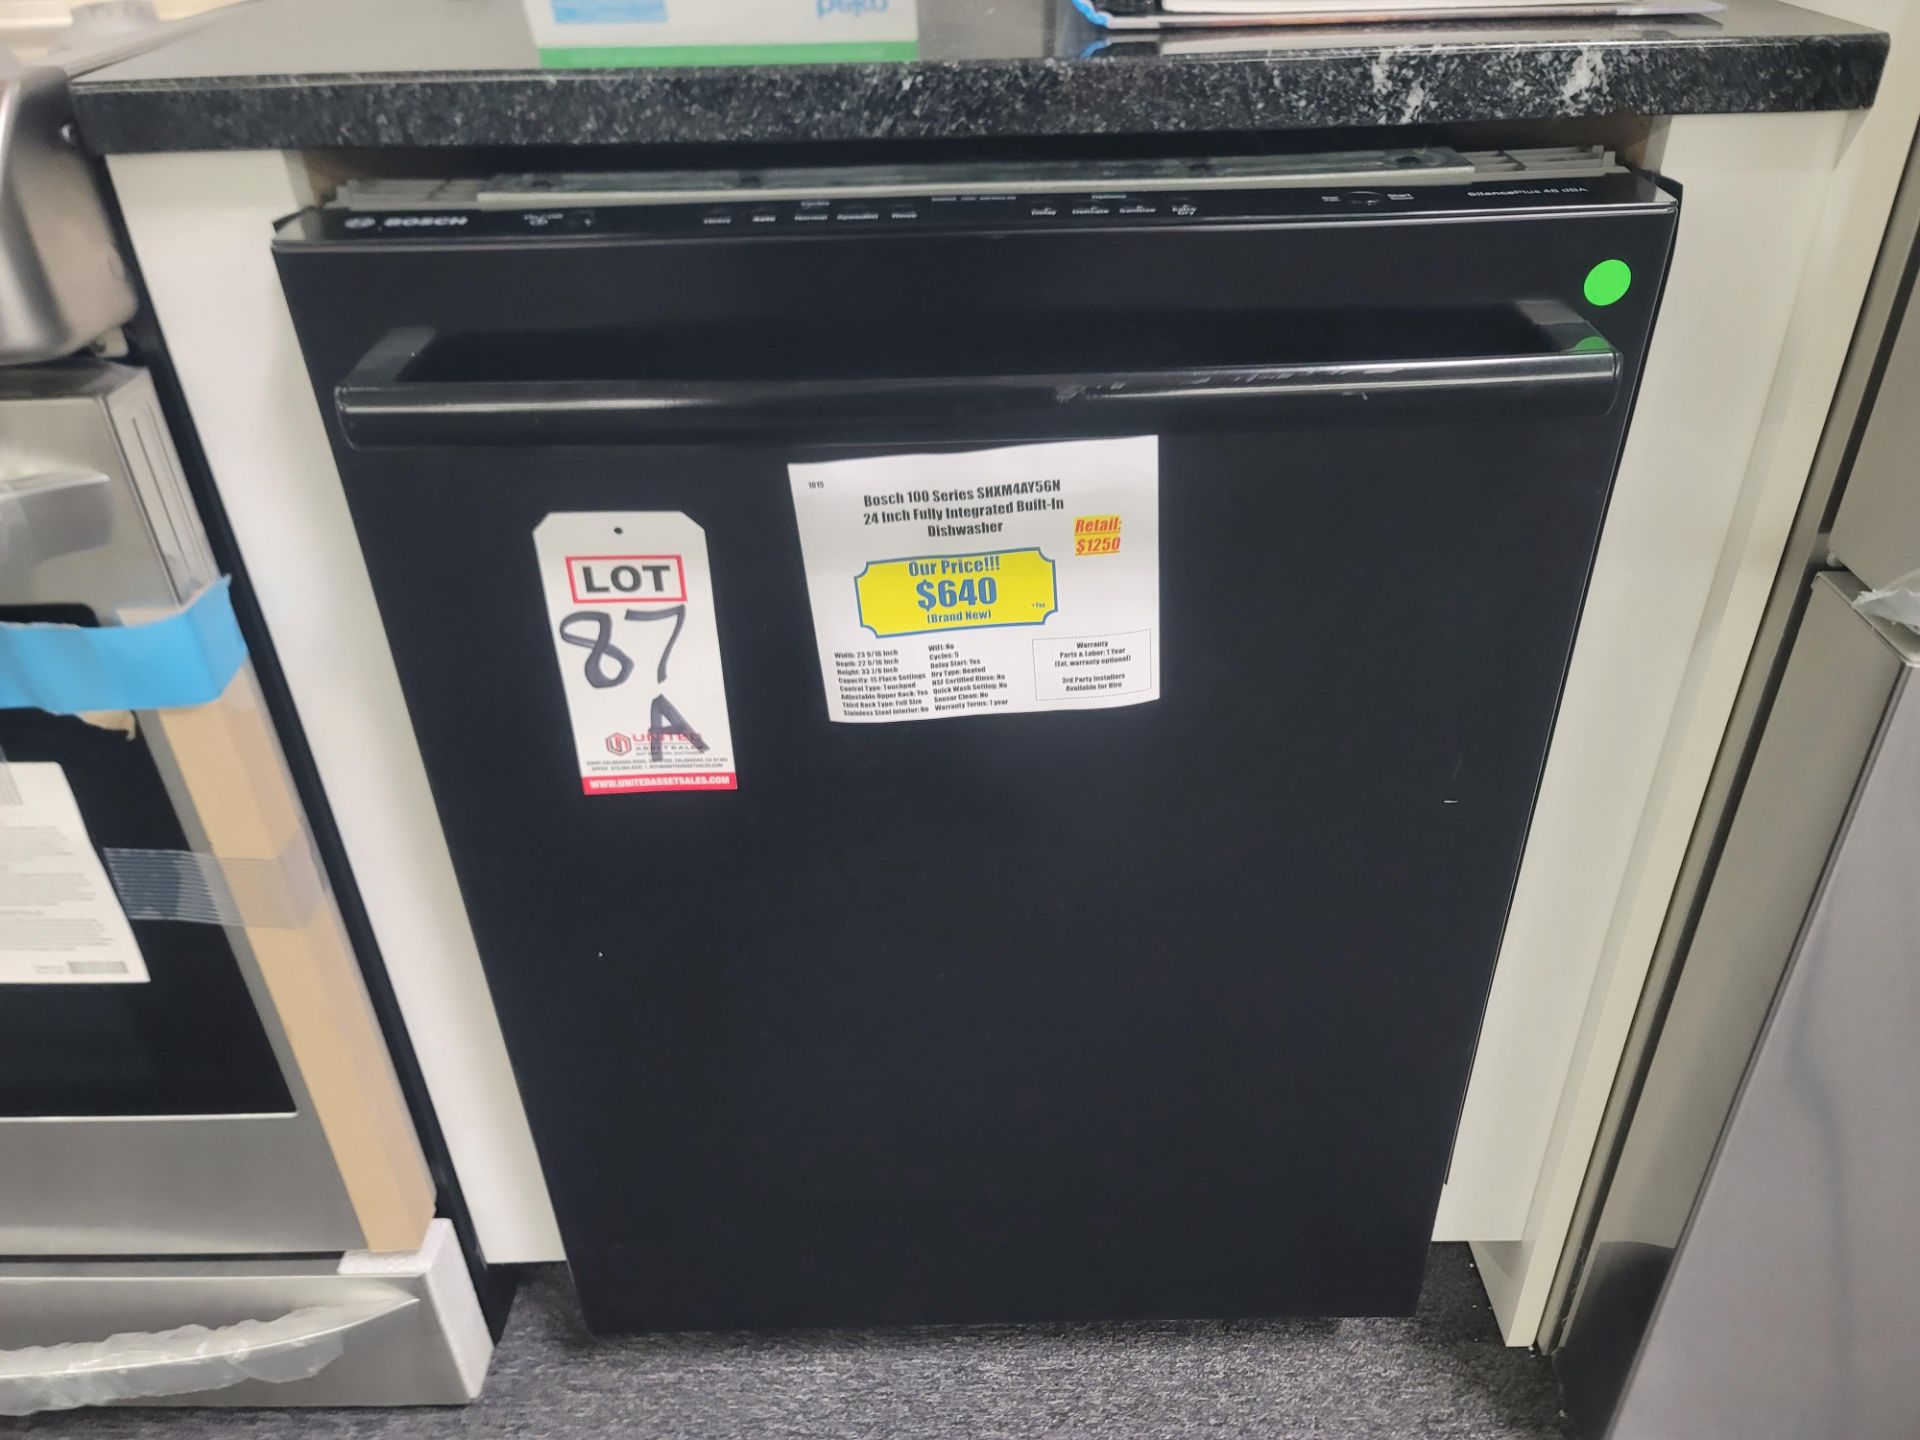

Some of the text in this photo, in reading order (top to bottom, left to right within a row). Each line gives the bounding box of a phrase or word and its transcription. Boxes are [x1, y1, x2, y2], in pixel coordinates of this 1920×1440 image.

[384, 216, 468, 227] BOSCH
[864, 480, 1060, 507] Bosch 100 Series SHXM4AY56N
[864, 498, 1064, 525] 24 Inch Fully Integrated Built-In
[928, 522, 1002, 536] Dishwasher
[1075, 516, 1122, 533] Retail:
[1076, 537, 1120, 555] $1250
[909, 556, 1000, 576] Our Price!!!
[582, 566, 670, 592] LOT
[916, 577, 997, 611] $640
[927, 609, 991, 624] (Brand New)
[560, 604, 685, 688] 87
[930, 653, 953, 661] Cycles:
[1101, 655, 1131, 664] optional)
[963, 666, 985, 674] Heated
[1094, 673, 1125, 681] Installers
[883, 682, 916, 690] Touchpad
[945, 676, 974, 684] Certified
[935, 702, 965, 711] Warranty
[648, 694, 711, 762] A
[589, 776, 730, 788] WWW.UNITEDASSETSALES.COM
